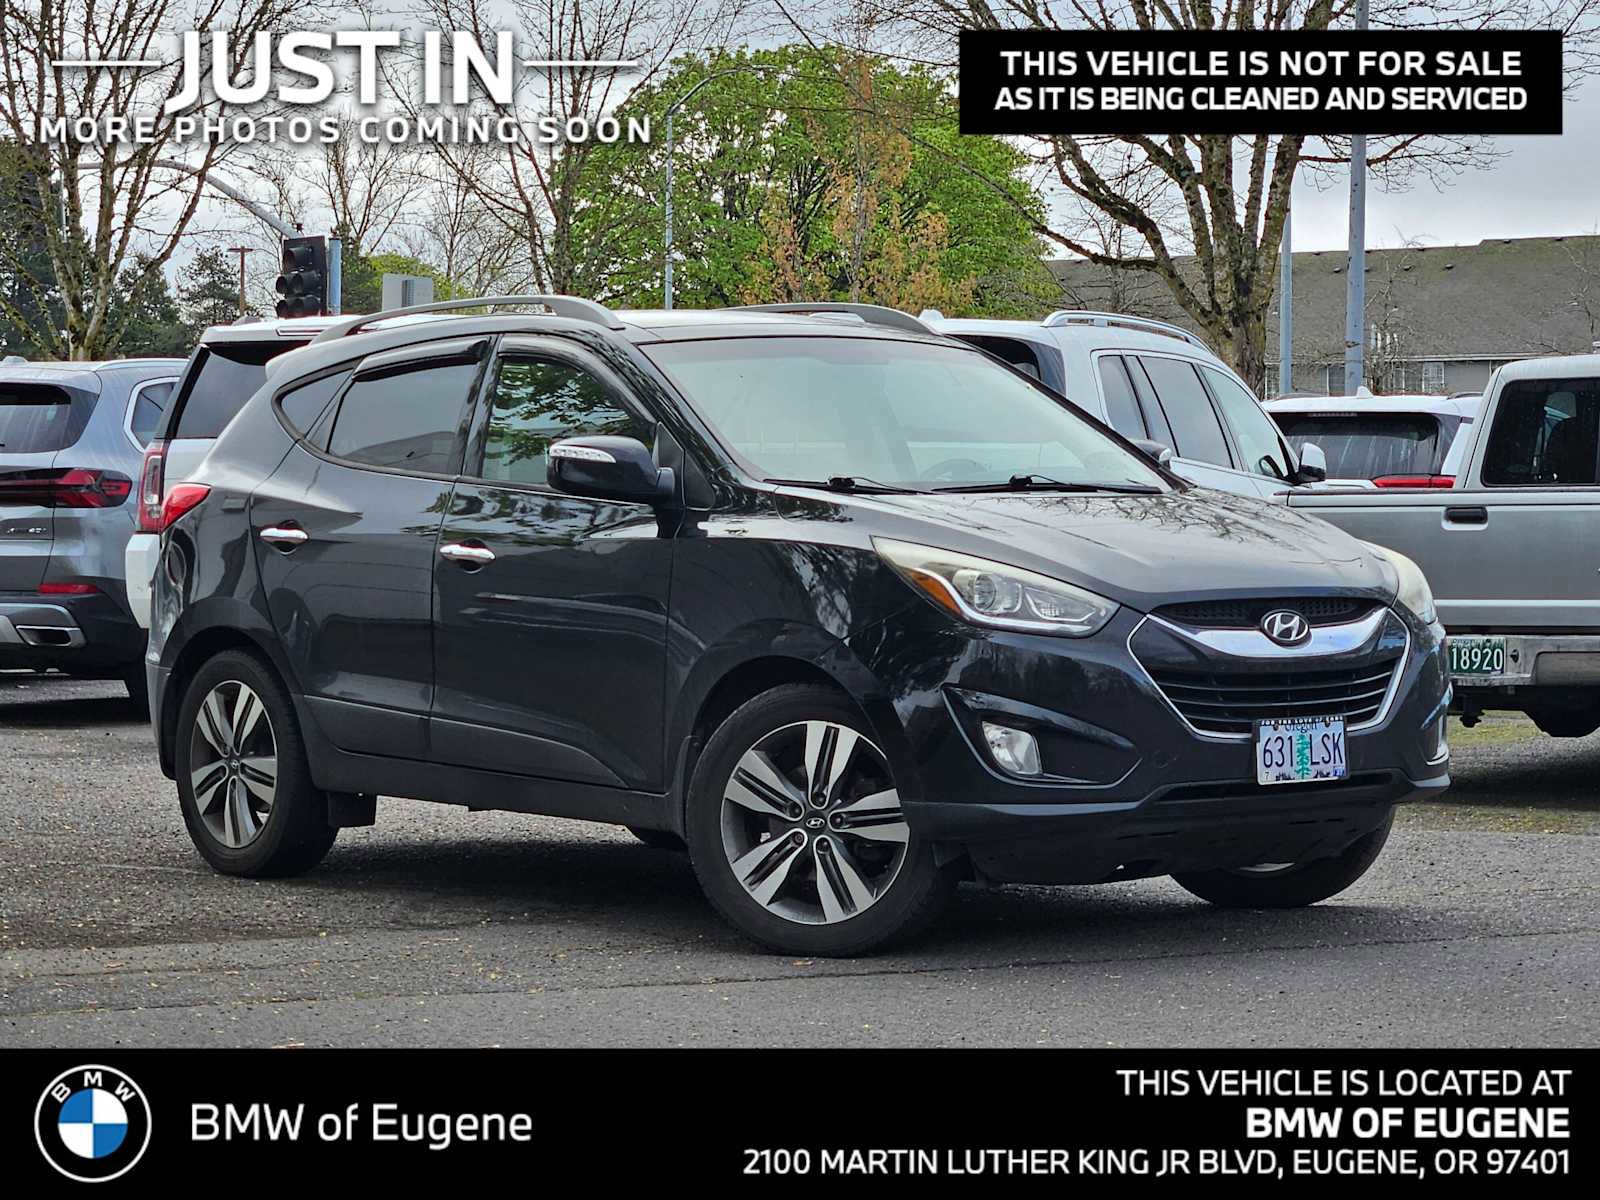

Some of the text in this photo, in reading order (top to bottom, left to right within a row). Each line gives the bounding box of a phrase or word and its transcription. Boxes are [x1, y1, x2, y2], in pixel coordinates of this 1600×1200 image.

[1451, 648, 1503, 670] 18920
[1263, 732, 1343, 768] 631 LSK
